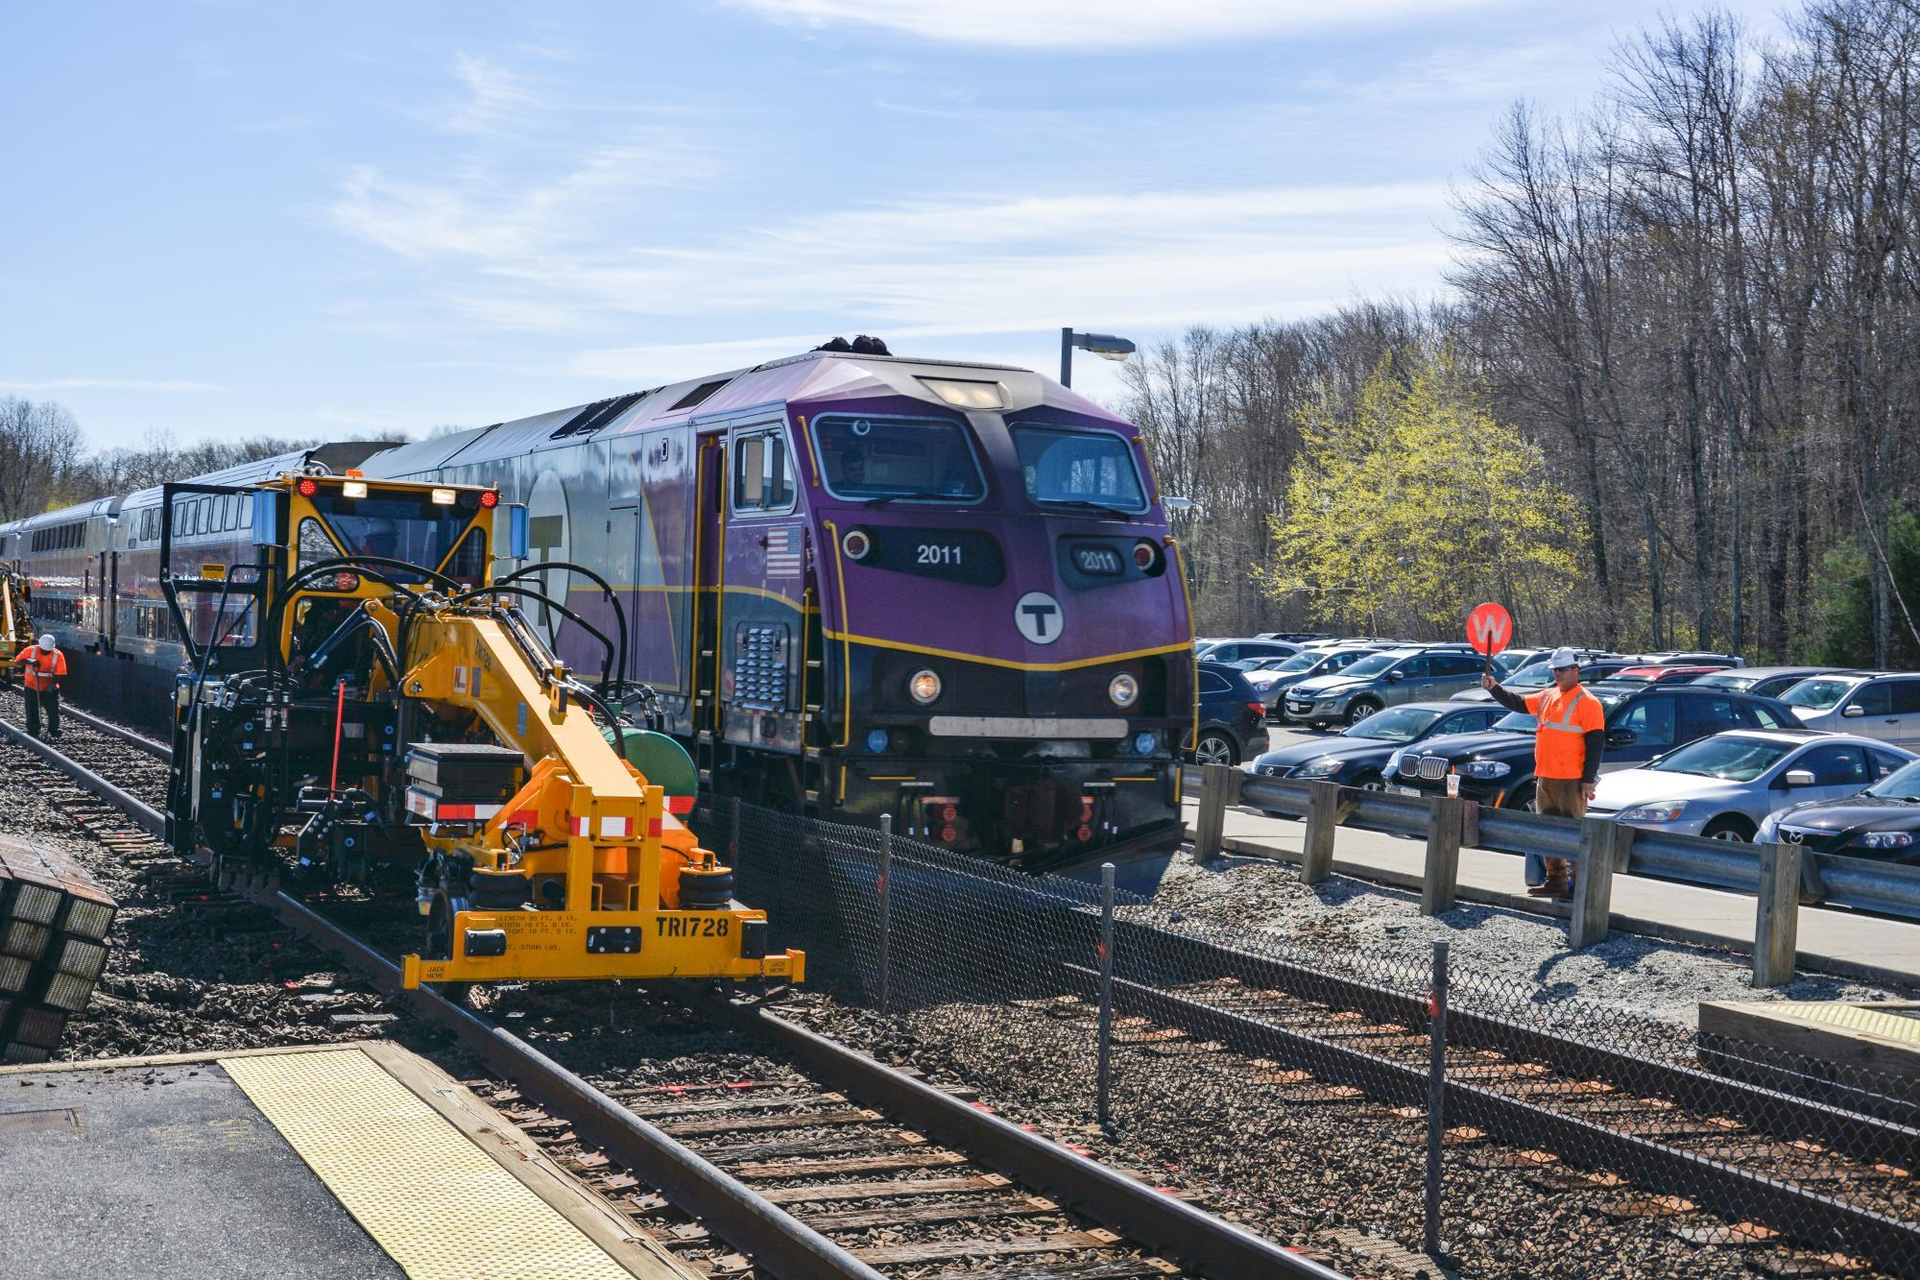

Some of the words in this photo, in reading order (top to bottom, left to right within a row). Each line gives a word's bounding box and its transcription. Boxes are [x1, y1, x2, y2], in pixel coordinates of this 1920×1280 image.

[917, 545, 962, 565] 2011
[1080, 551, 1117, 571] 2011
[529, 515, 563, 627] T
[1021, 604, 1057, 637] T
[1472, 614, 1508, 644] W
